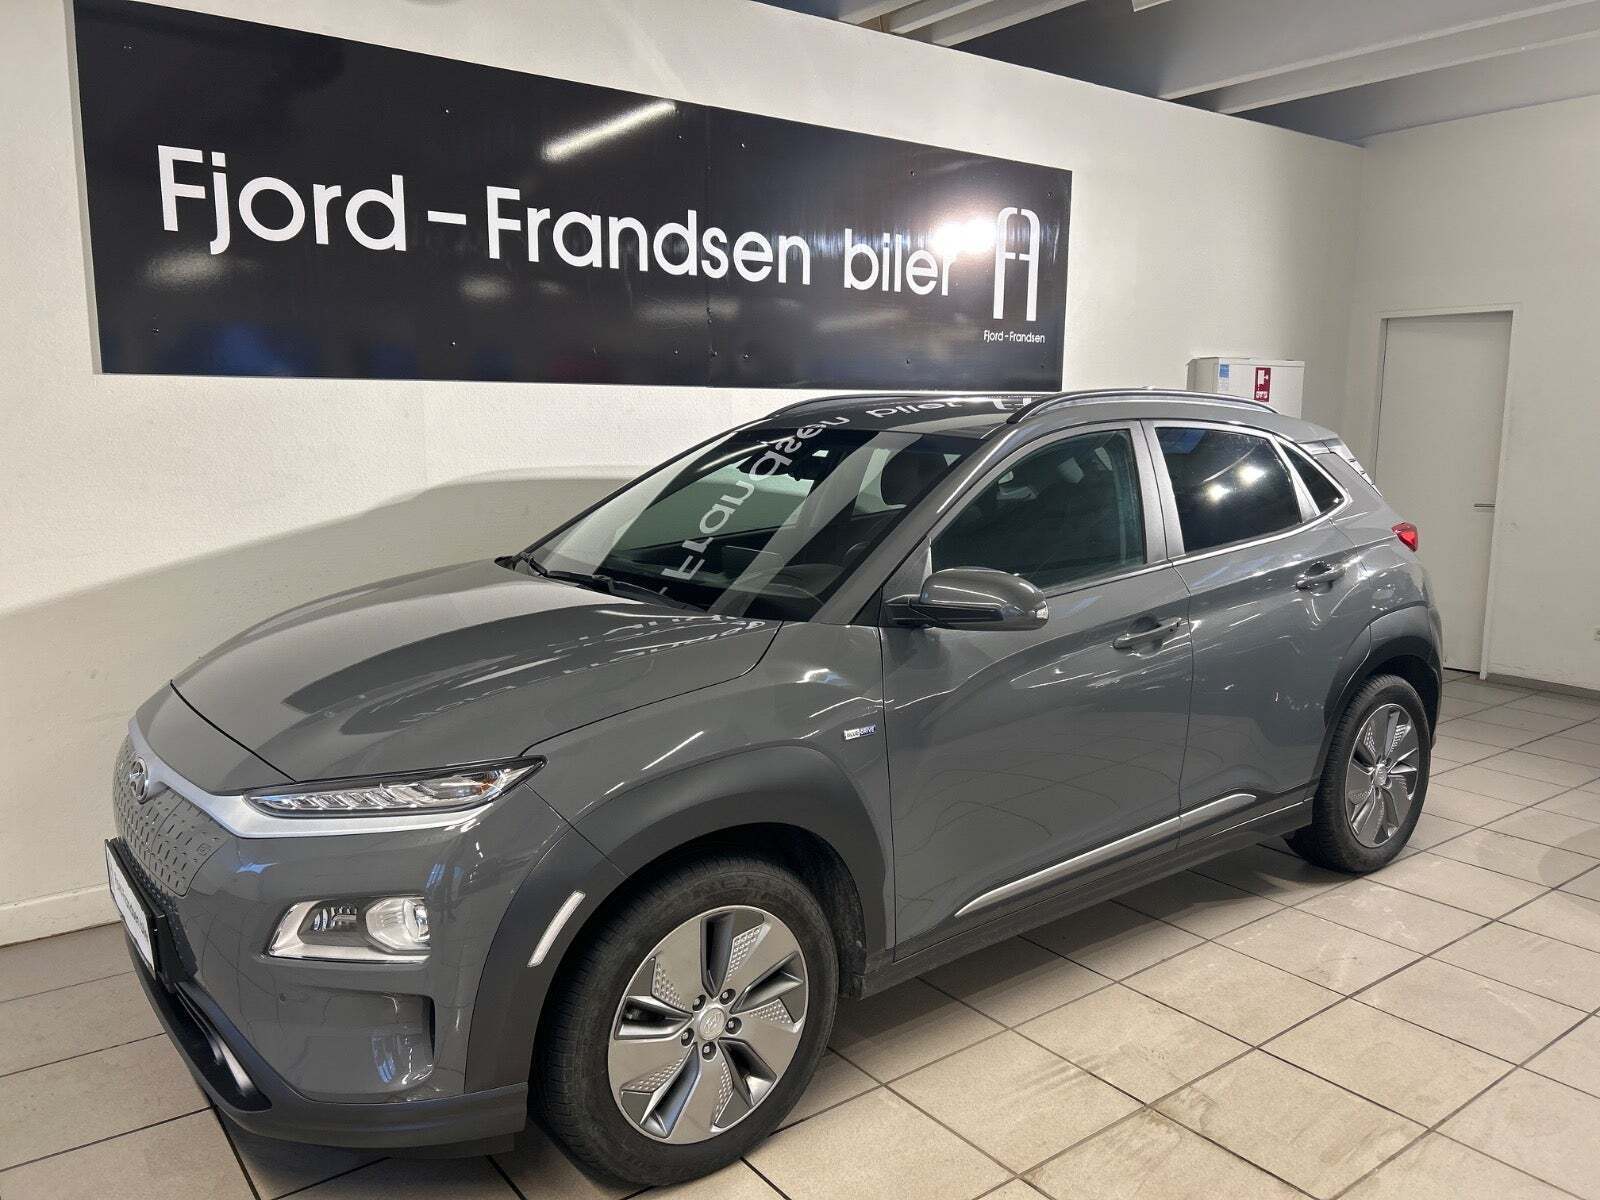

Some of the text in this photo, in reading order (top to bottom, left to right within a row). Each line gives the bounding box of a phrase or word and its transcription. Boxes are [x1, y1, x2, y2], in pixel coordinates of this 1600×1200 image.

[158, 145, 406, 255] Fjord
[486, 187, 810, 286] Frandsen
[844, 228, 956, 295] biler
